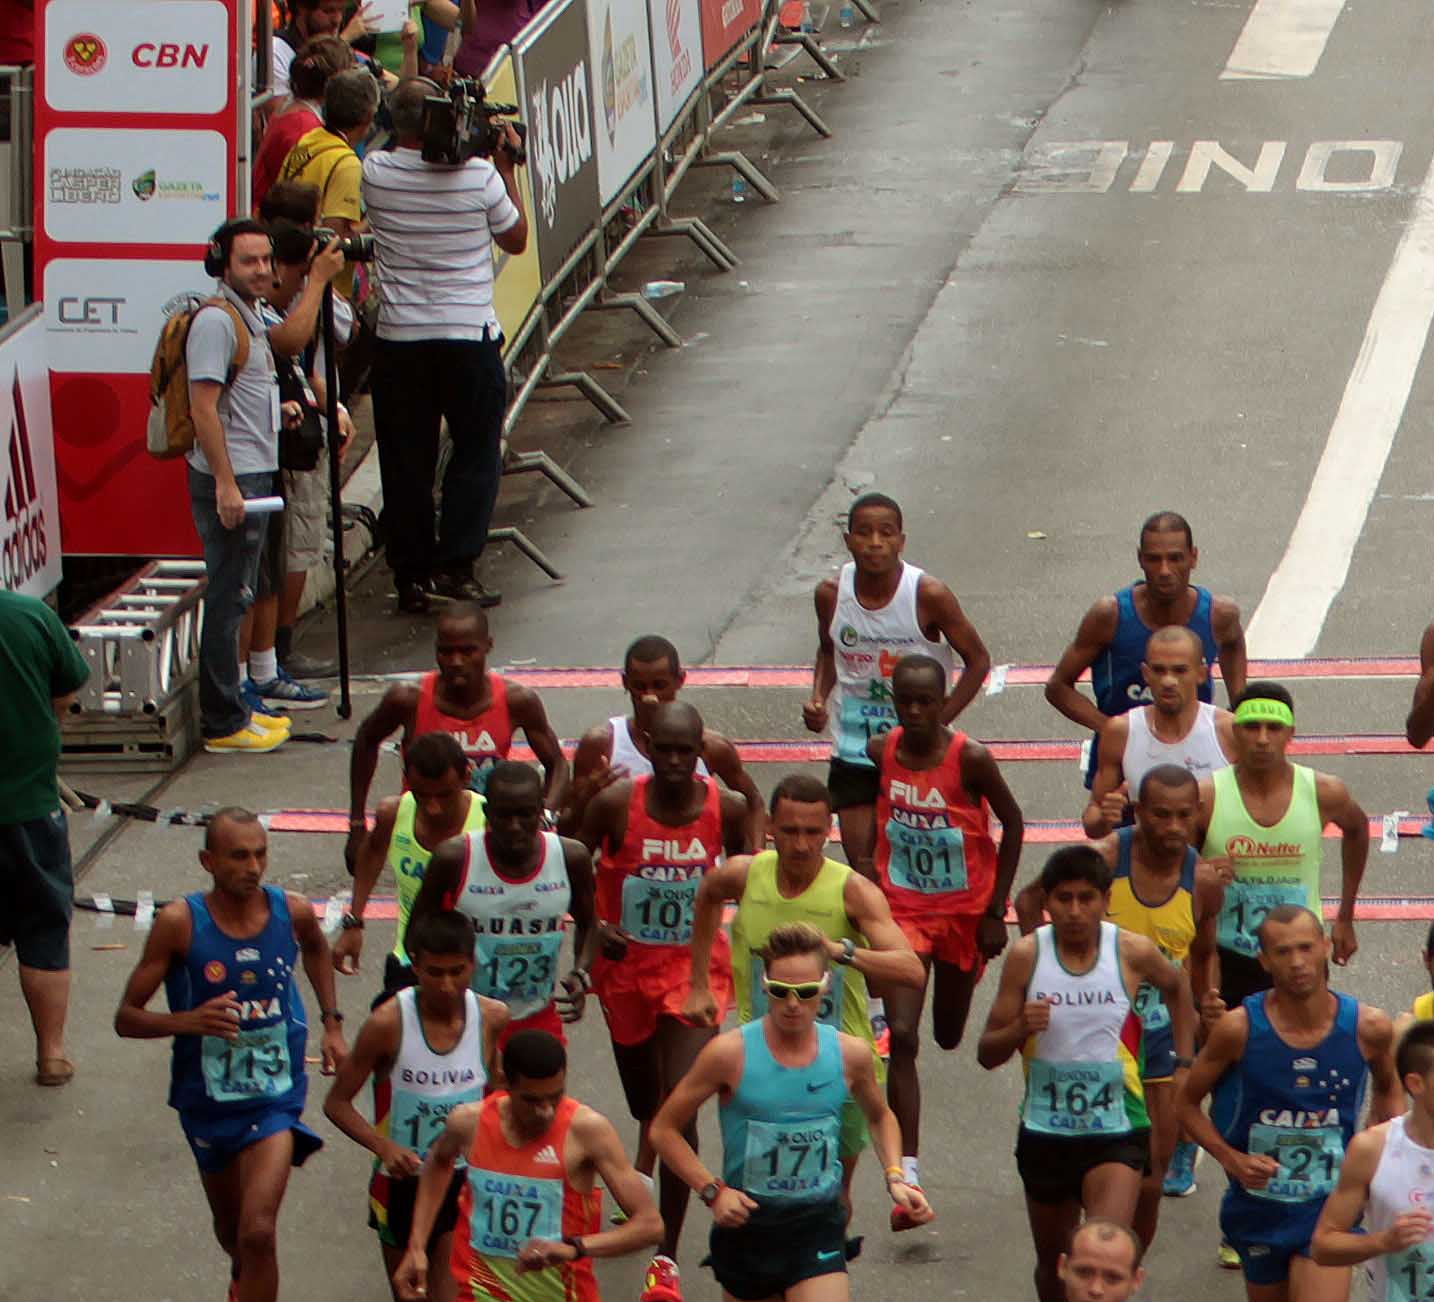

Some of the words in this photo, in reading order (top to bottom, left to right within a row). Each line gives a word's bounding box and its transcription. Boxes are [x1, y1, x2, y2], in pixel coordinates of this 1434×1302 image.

[132, 43, 208, 68] CBN
[59, 298, 126, 323] CET
[889, 779, 947, 808] FILA
[892, 808, 949, 829] CAIXA
[642, 838, 707, 861] FILA
[901, 846, 951, 877] 101
[480, 957, 551, 990] 123
[217, 1045, 285, 1078] 113
[402, 1068, 475, 1085] BOLIVIA
[1042, 1081, 1114, 1115] 164
[1049, 1114, 1103, 1130] CAIXA
[1260, 1108, 1340, 1127] CAIXA
[762, 1140, 829, 1176] 171
[484, 1179, 539, 1199] CAIXA
[767, 1176, 820, 1191] CAIXA
[484, 1200, 543, 1237] 167
